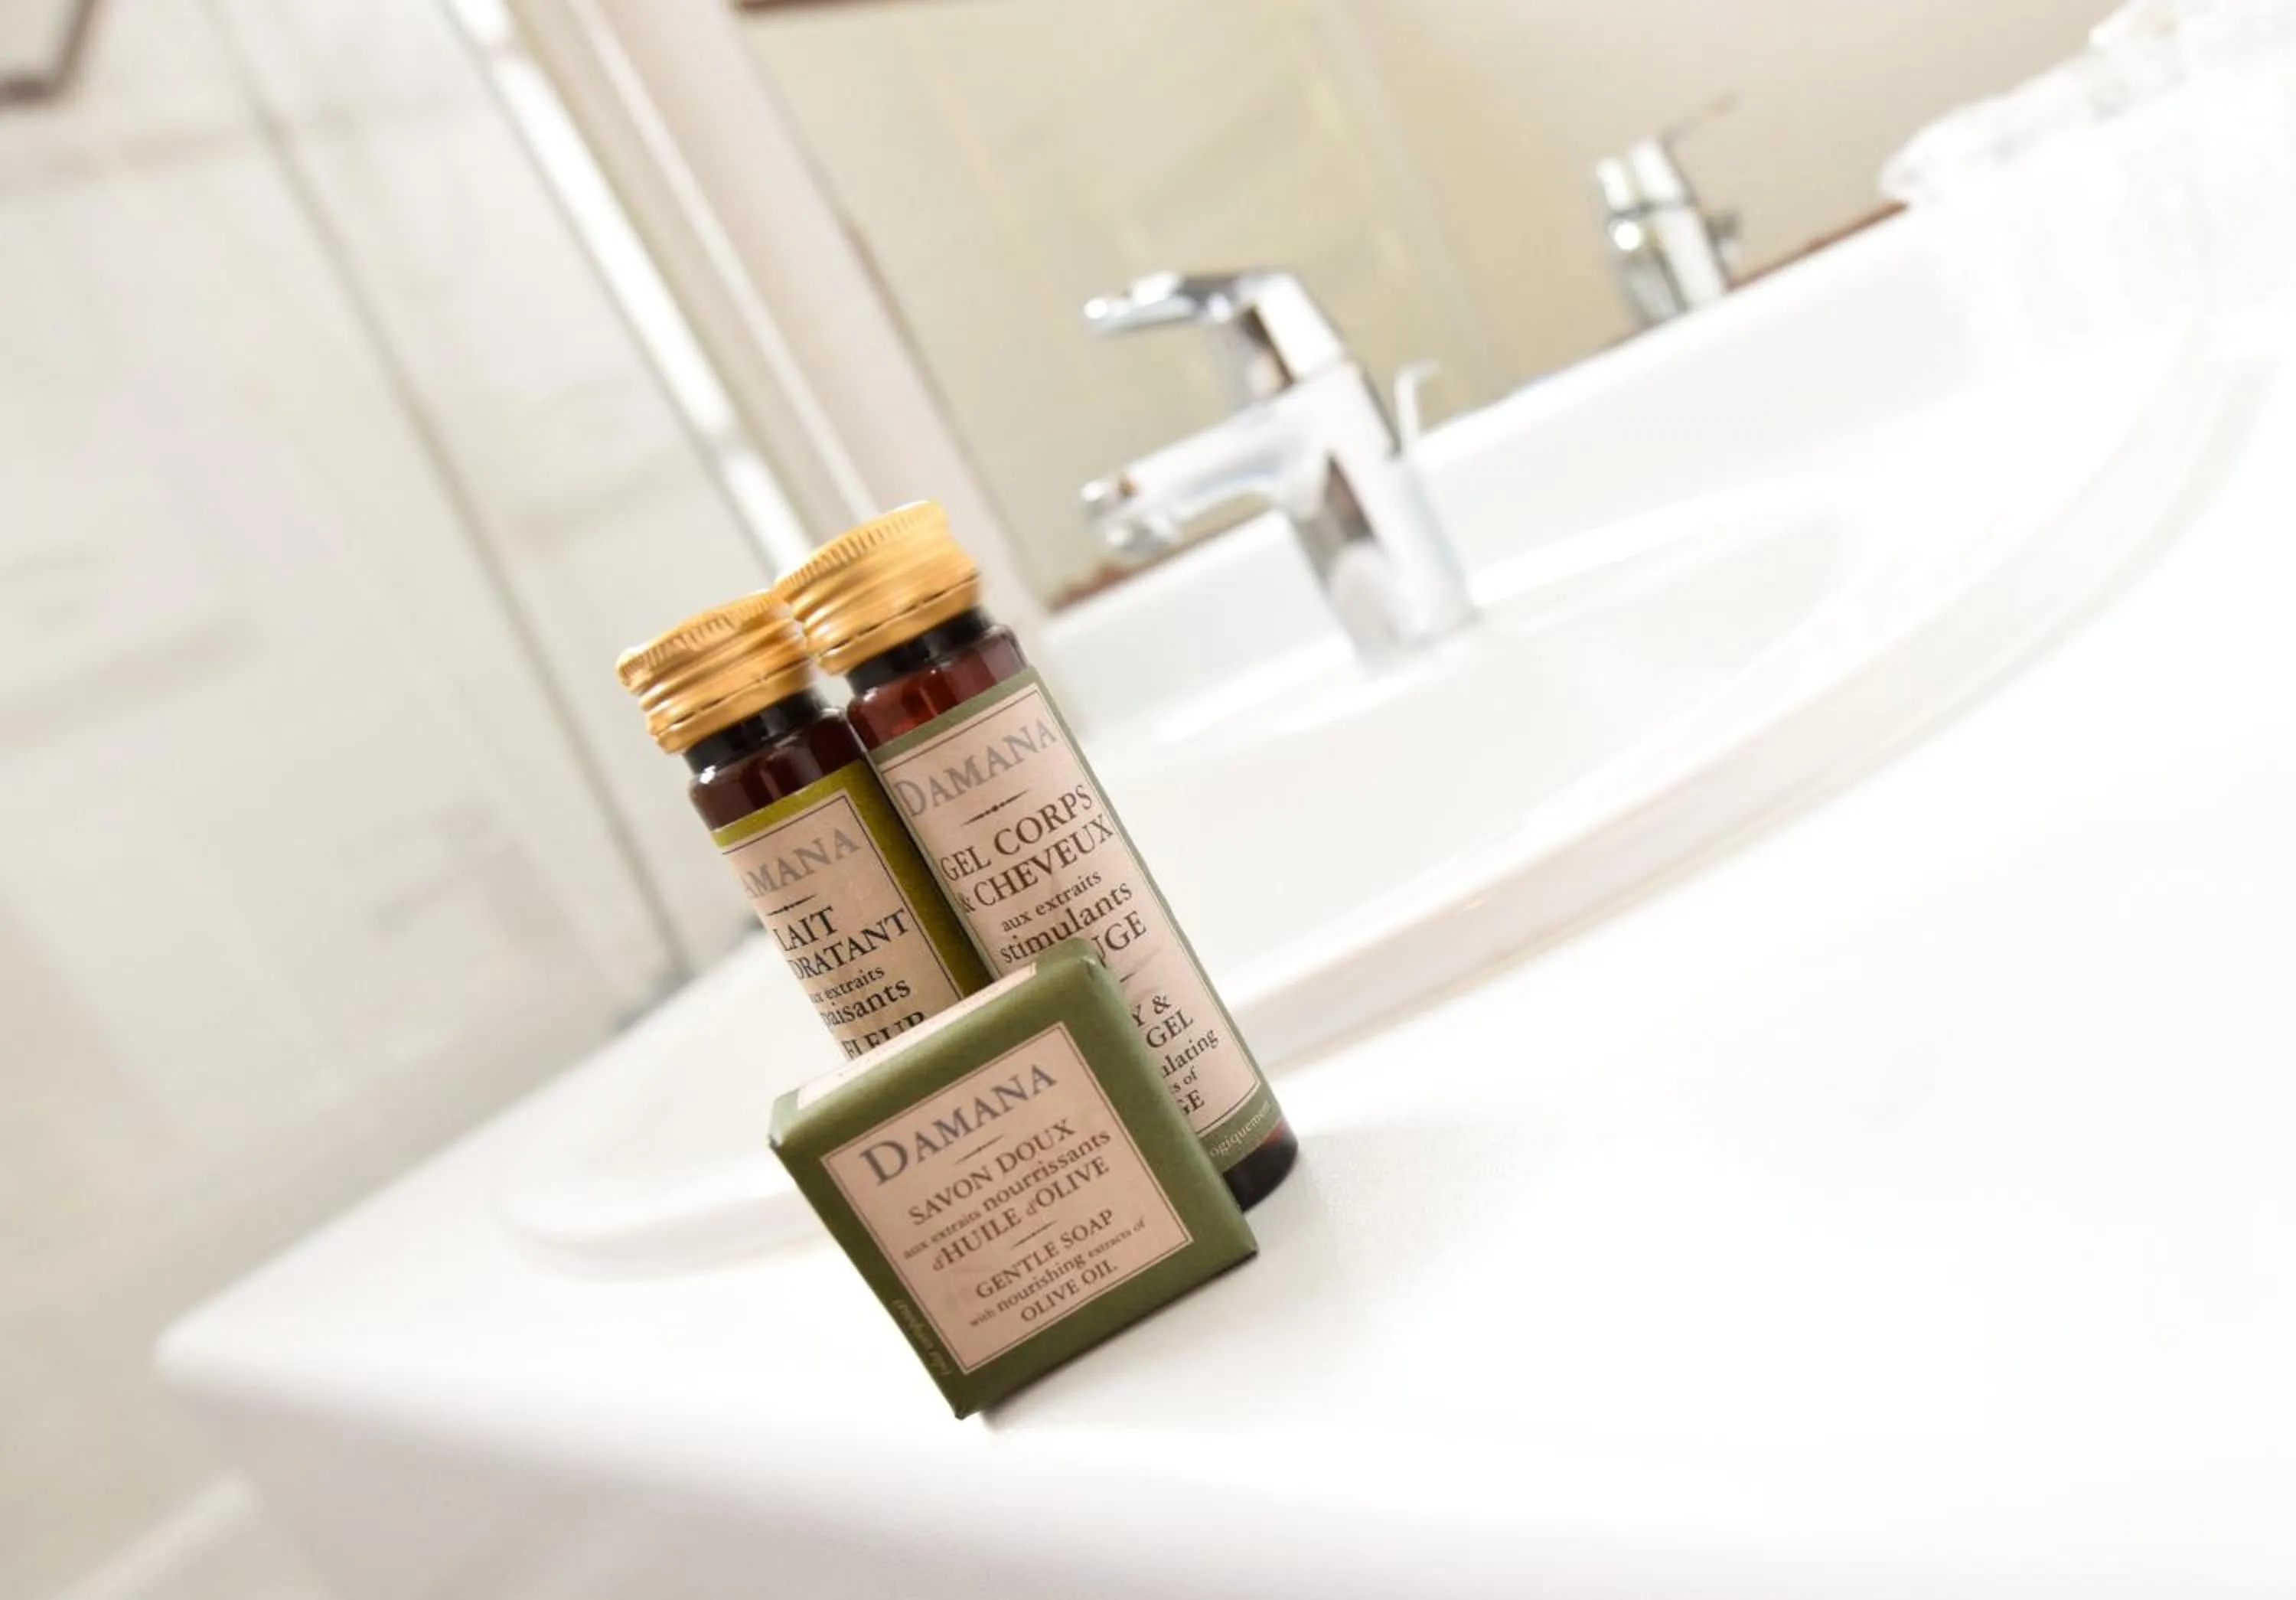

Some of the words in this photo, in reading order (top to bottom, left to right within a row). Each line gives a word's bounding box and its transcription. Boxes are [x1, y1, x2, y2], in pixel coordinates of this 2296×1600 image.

[894, 718, 1058, 818] DAMANA
[940, 845, 992, 882] GEL
[993, 784, 1093, 856] CORPS
[974, 813, 1114, 906] CHEVEUX
[772, 906, 838, 952] LAIT
[1000, 883, 1133, 964] stimulants
[1002, 910, 1033, 932] aux
[1035, 870, 1102, 916] extraits
[824, 967, 885, 1000] extraits
[1152, 994, 1172, 1015] &
[1146, 1008, 1194, 1049] GEL
[1182, 1066, 1198, 1085] of
[859, 1064, 1057, 1186] DAMANA
[904, 1242, 928, 1259] aux
[931, 1210, 982, 1244] extraits
[983, 1130, 1111, 1213] nourrissants
[908, 1165, 994, 1226] SAVON
[996, 1118, 1075, 1174] DOUX
[970, 1308, 996, 1327] with
[996, 1251, 1086, 1314] nourishing
[1088, 1227, 1132, 1258] extracts
[1132, 1216, 1146, 1234] of
[976, 1240, 1060, 1299] GENTLE
[1059, 1209, 1114, 1248] SOAP
[1020, 1278, 1081, 1323] OLIVE
[1081, 1259, 1118, 1286] OIL
